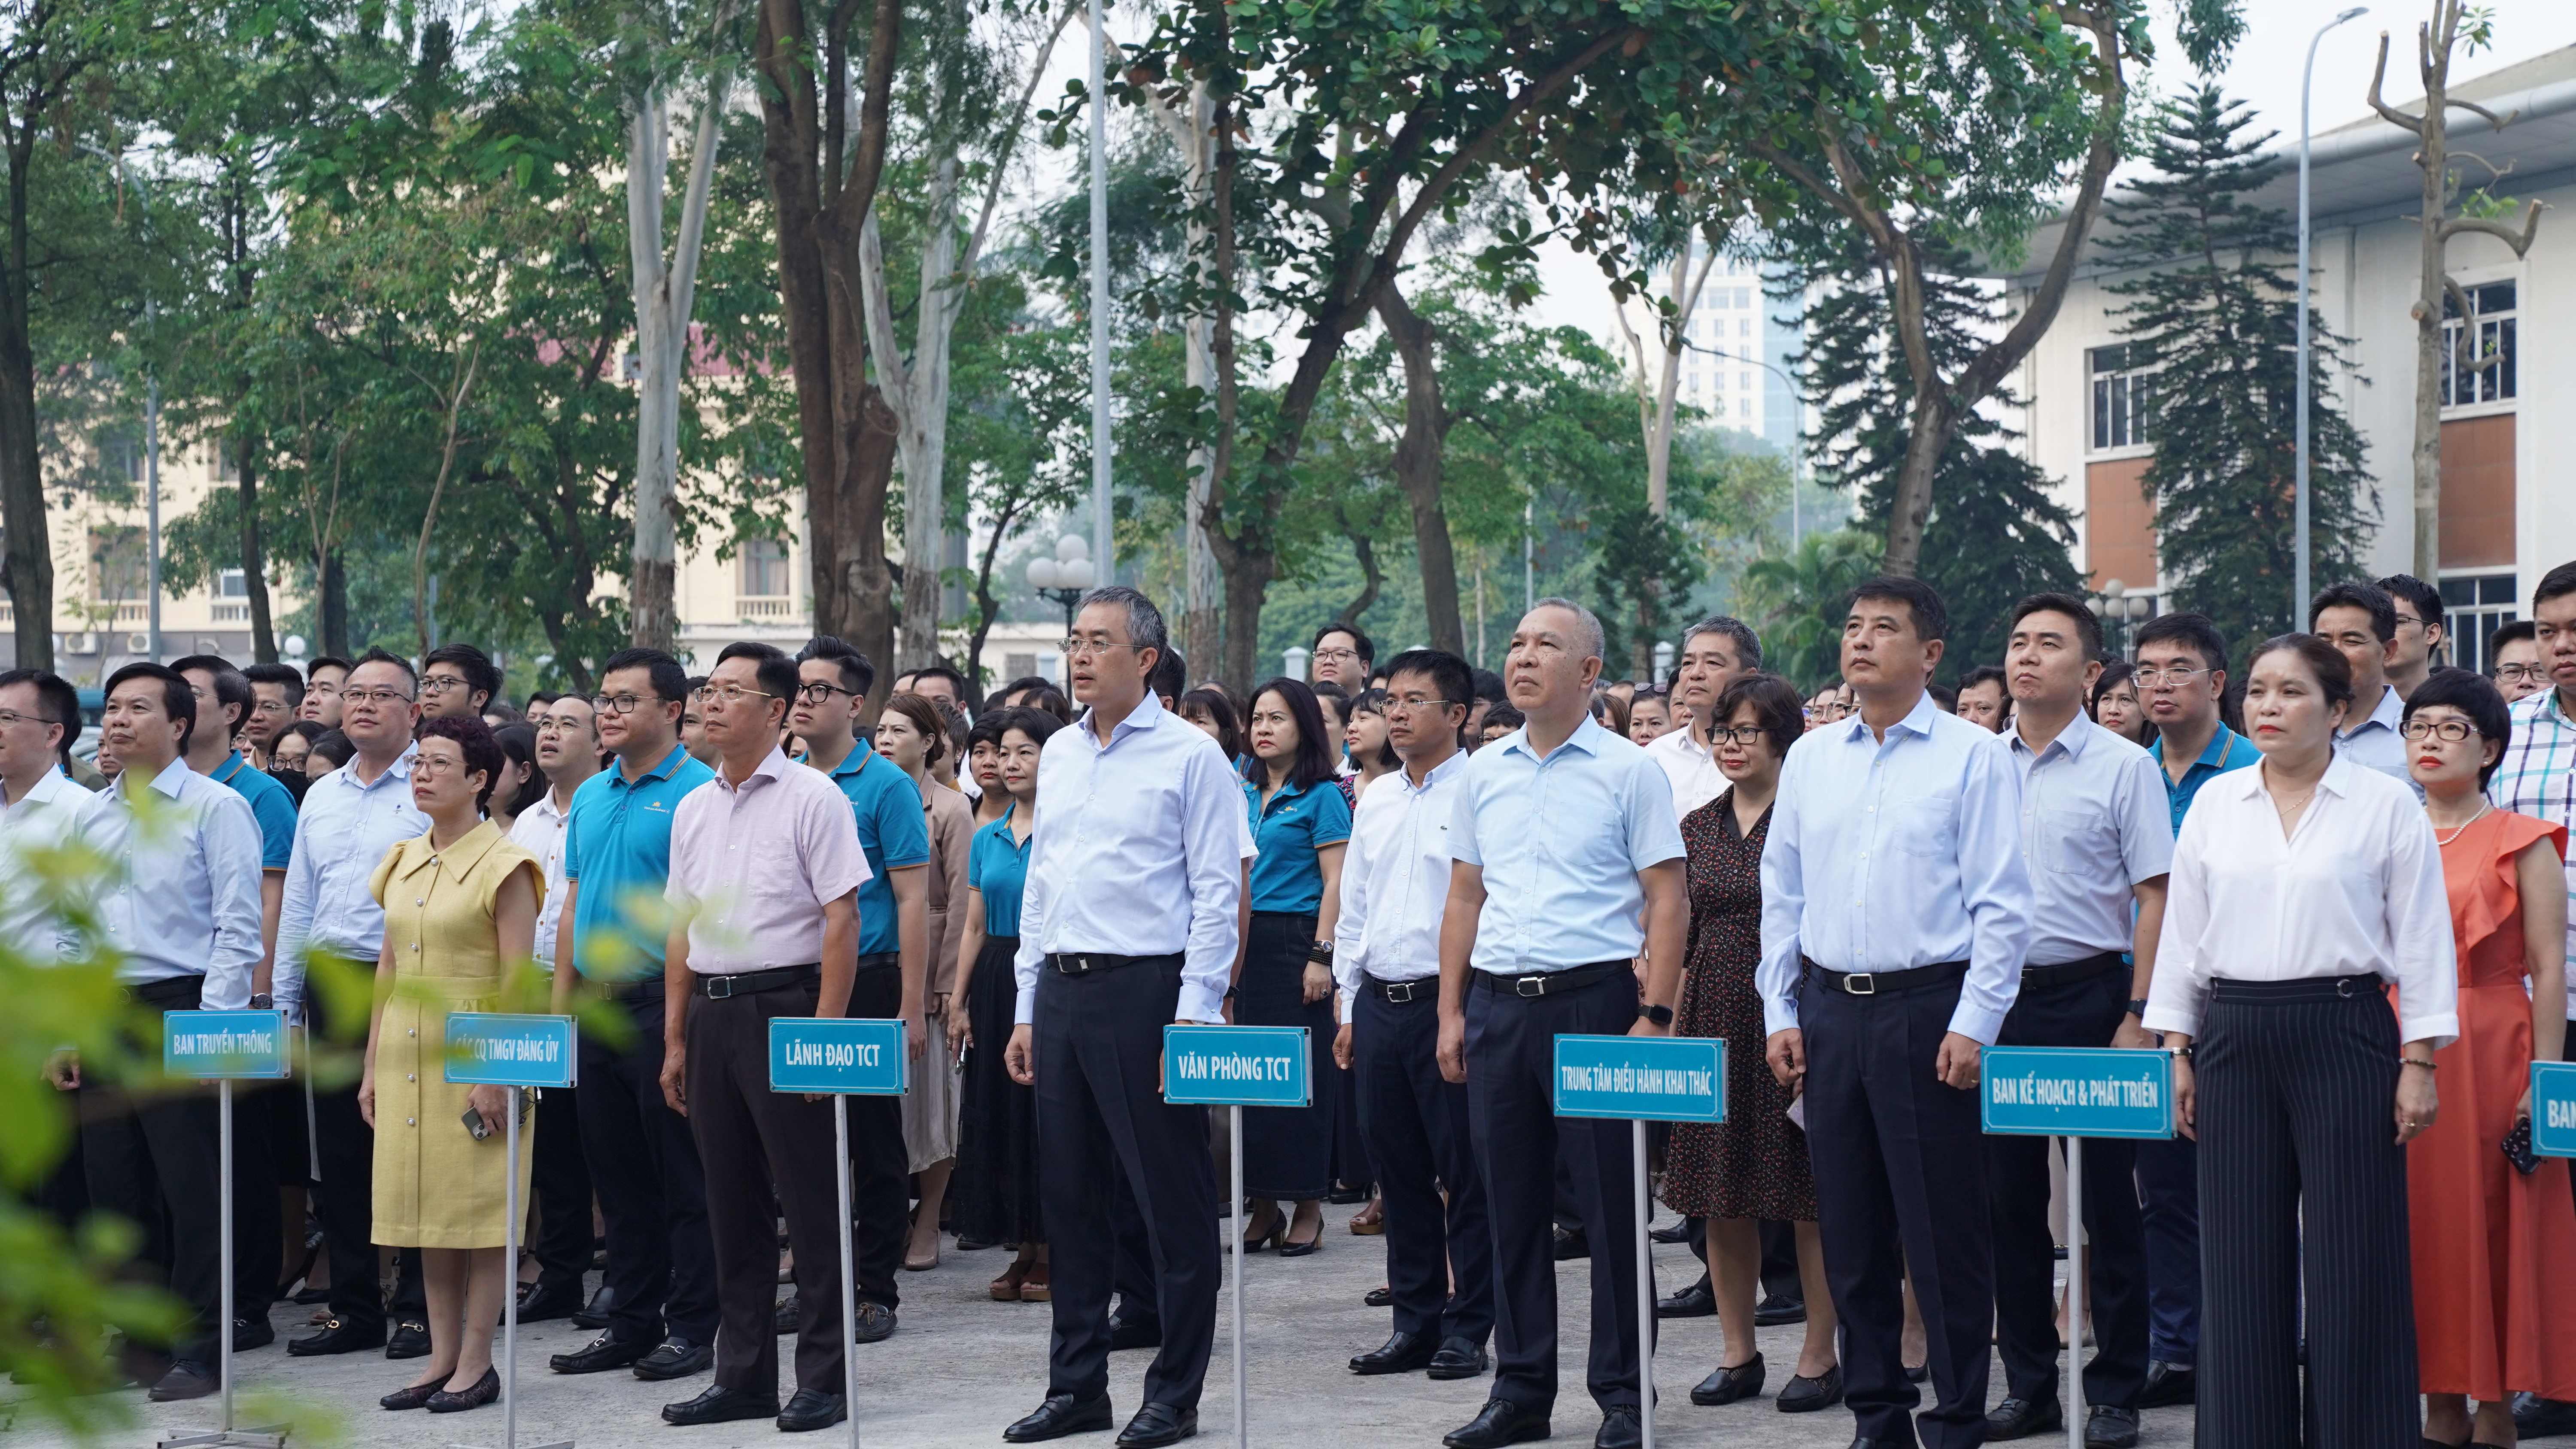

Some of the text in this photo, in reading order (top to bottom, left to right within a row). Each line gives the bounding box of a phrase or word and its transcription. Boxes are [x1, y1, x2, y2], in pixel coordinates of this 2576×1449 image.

[174, 1028, 272, 1055] BAN TRUYỀN THÔNG
[474, 1038, 486, 1062] CQ
[488, 1039, 516, 1061] TMGV
[516, 1033, 544, 1062] ĐẢNG
[546, 1034, 559, 1062] ỦY
[786, 1039, 880, 1072] LÃNH ĐẠO TCT
[1178, 1051, 1291, 1081] VĂN PHÒNG TCT
[1561, 1061, 1712, 1096] TRUNG TÂM ĐIỀU HÀNH KHAI THÁC
[1993, 1070, 2158, 1112] BAN KẾ HOẠCH & PHÁT TRIỂN
